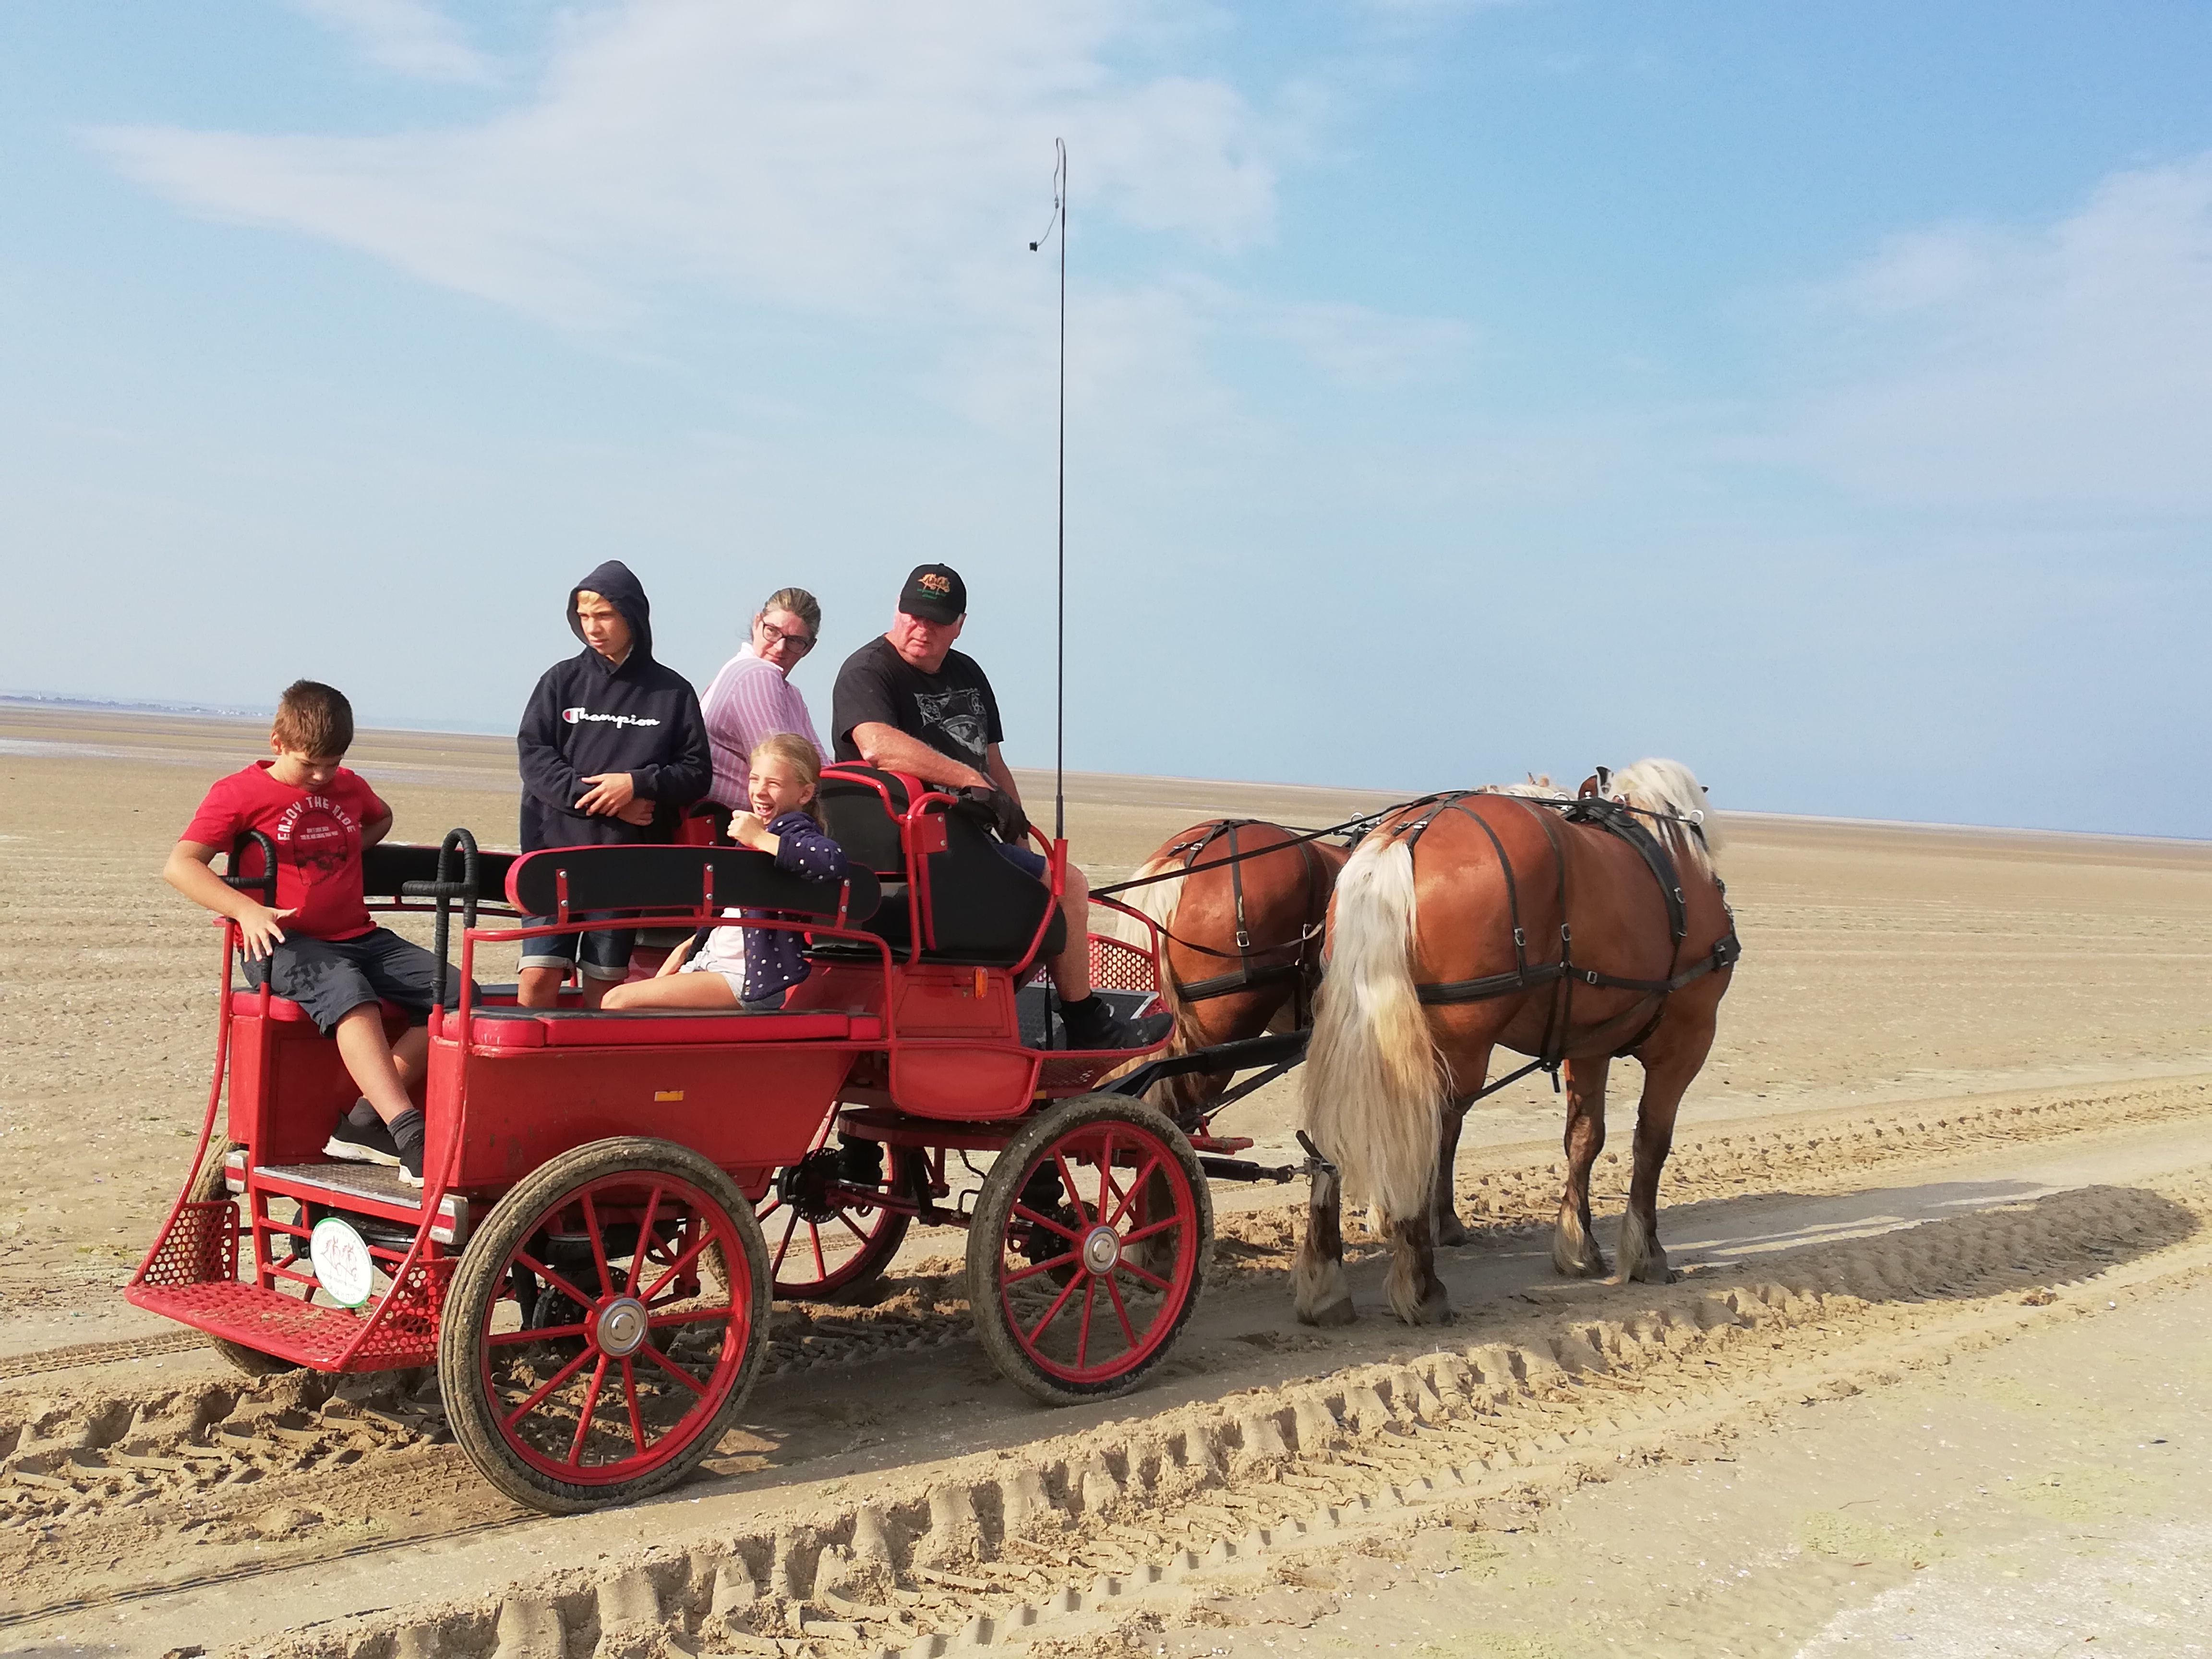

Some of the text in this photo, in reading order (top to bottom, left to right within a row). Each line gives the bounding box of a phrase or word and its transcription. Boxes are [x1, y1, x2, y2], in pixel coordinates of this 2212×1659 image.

[562, 707, 661, 729] Champion
[277, 796, 356, 841] ENJOY THE RIDE
